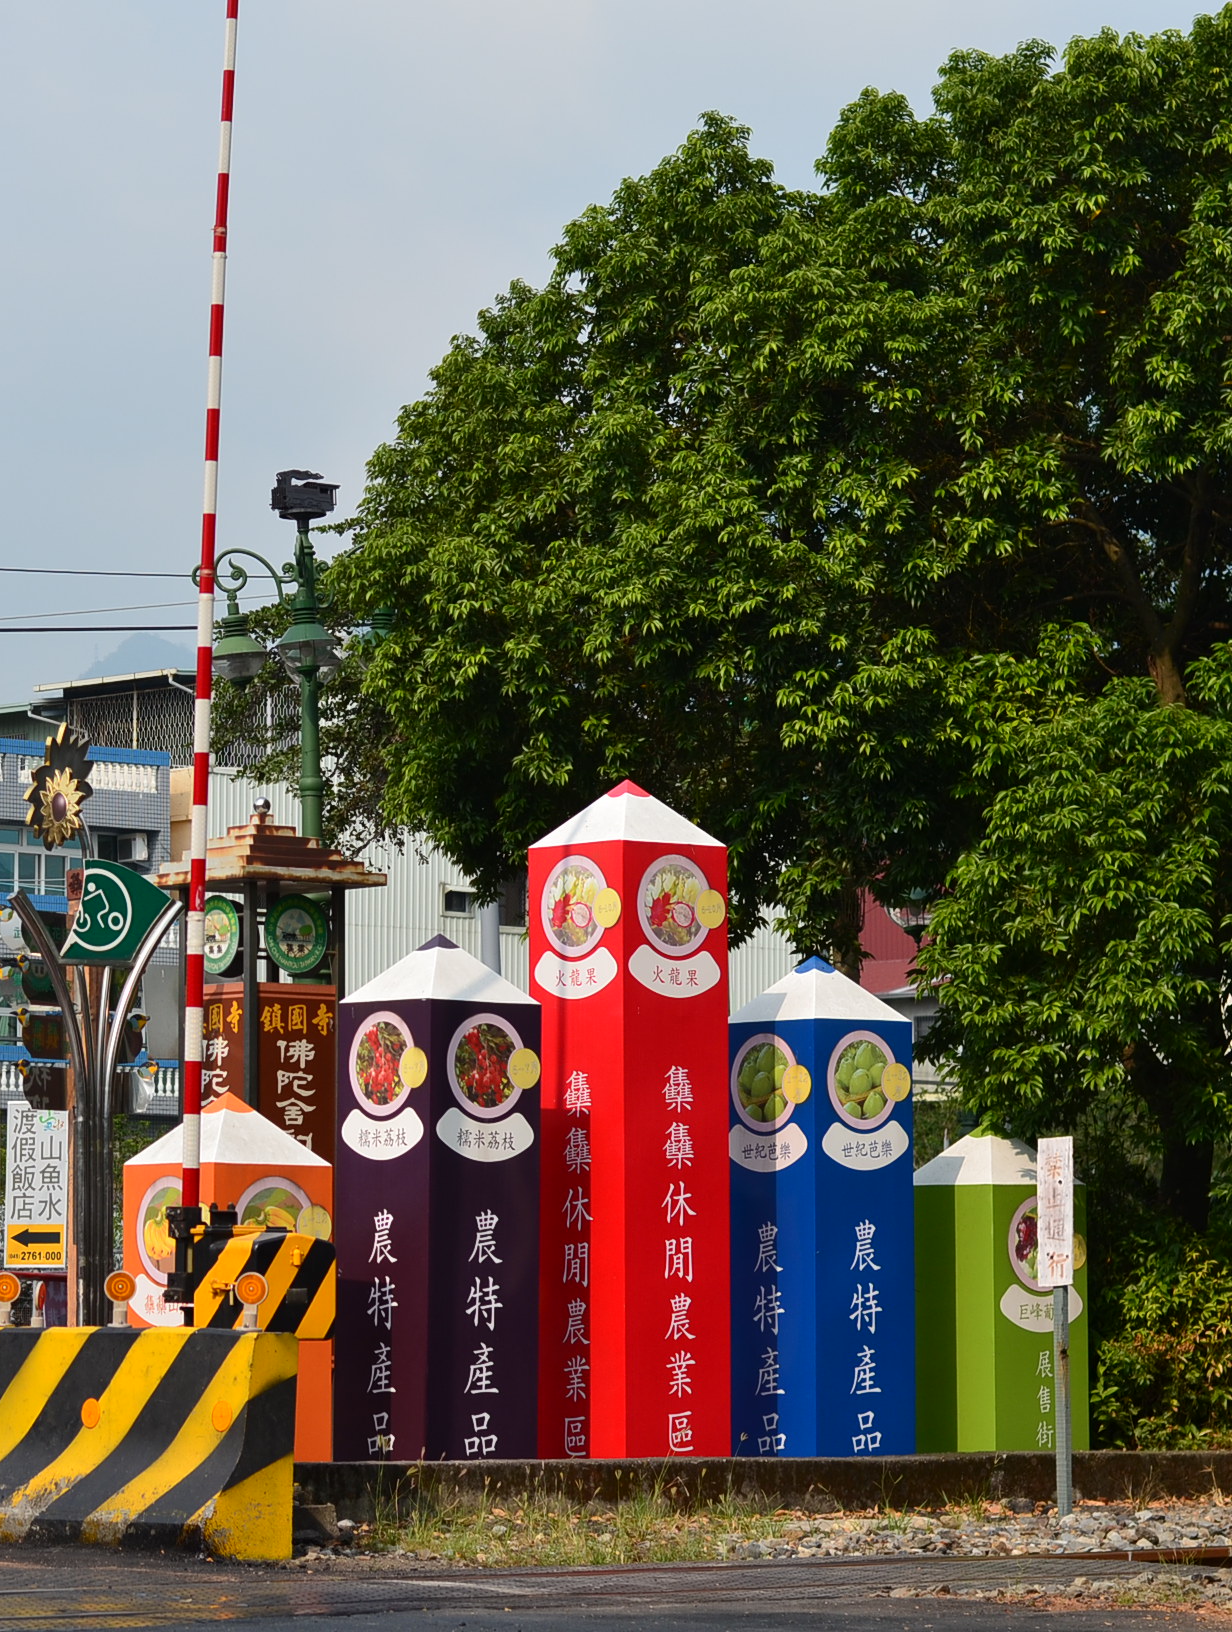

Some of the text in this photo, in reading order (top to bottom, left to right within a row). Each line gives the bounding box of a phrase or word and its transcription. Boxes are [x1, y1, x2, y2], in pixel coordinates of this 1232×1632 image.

[556, 967, 598, 987] 火龍果
[652, 965, 699, 987] 火龍果
[203, 1000, 242, 1033] 國寺
[260, 1003, 333, 1036] 鎮國寺
[201, 1036, 230, 1106] 佛陀
[358, 1128, 408, 1148] 糯米荔枝
[457, 1128, 516, 1151] 糯米荔枝
[742, 1141, 791, 1160] 世紀芭樂
[841, 1139, 893, 1158] 世紀芭樂
[11, 1108, 37, 1221] 渡假飯店
[38, 1135, 63, 1221] 山魚水
[1044, 1152, 1069, 1279] 禁止通行
[367, 1209, 399, 1456] 農特產品
[464, 1209, 504, 1457] 農特產品
[753, 1221, 786, 1454] 農特產品
[849, 1219, 883, 1453] 農特產品
[1019, 1303, 1054, 1321] 巨峰葡
[1035, 1350, 1055, 1448] 展售街
